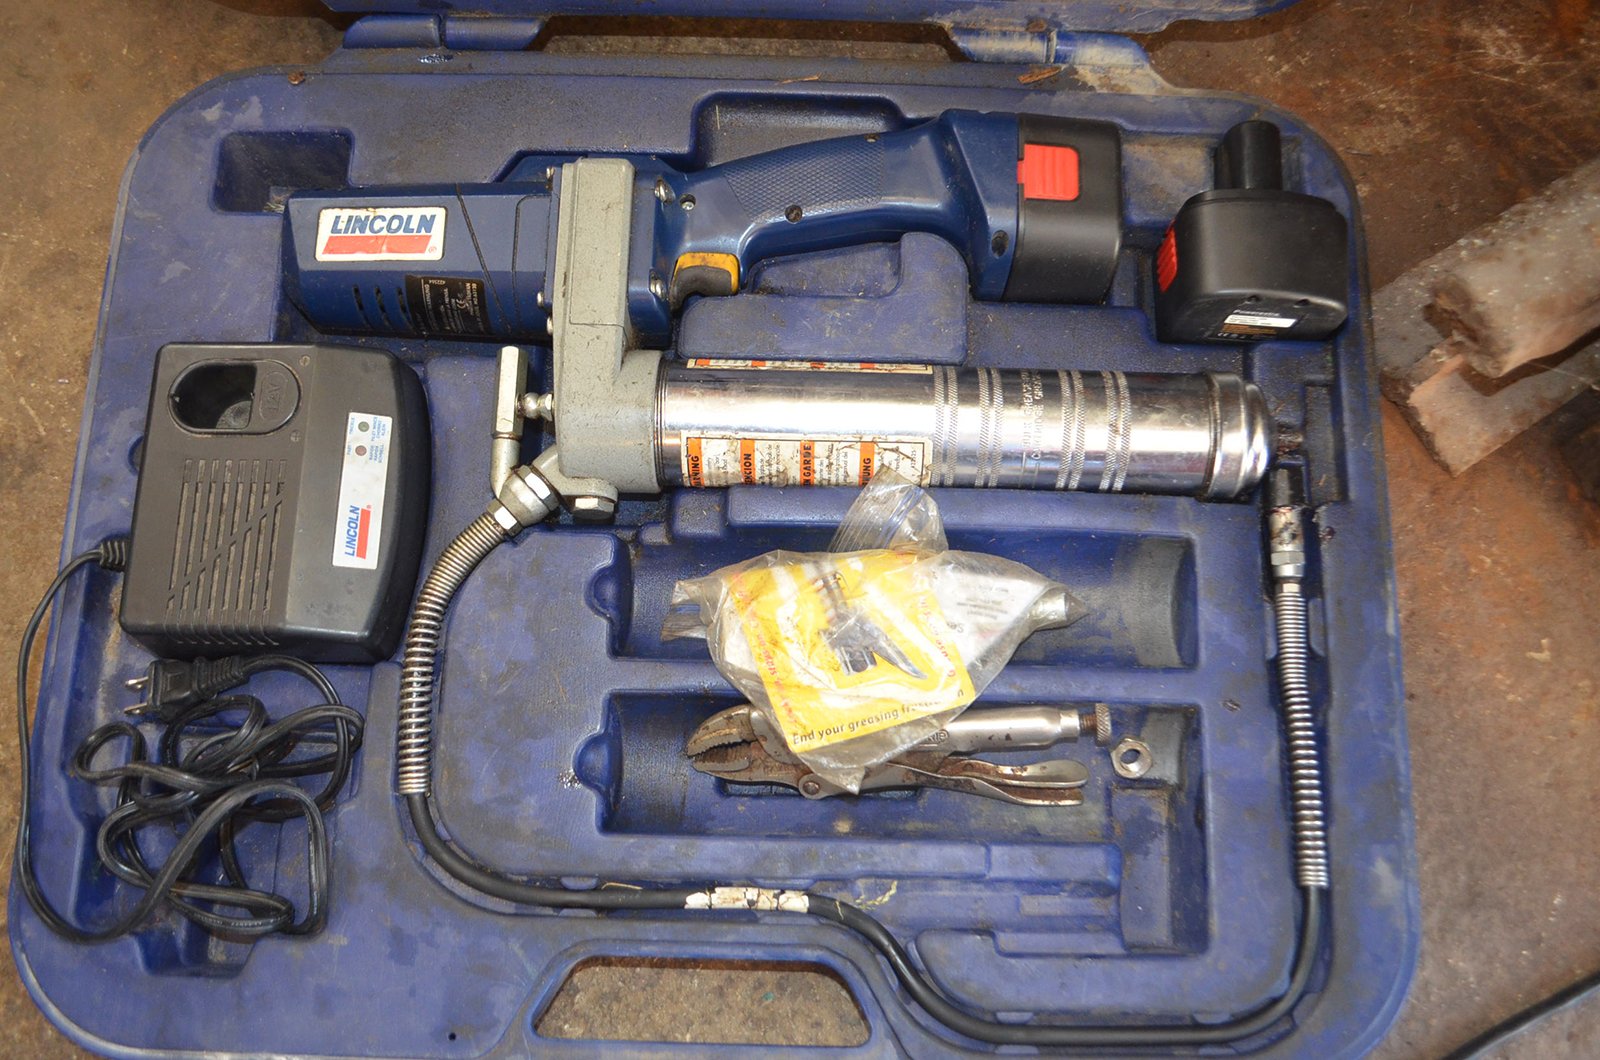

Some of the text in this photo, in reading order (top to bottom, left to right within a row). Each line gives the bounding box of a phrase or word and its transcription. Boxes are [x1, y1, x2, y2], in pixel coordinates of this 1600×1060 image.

[330, 214, 437, 235] LINCOLN
[690, 455, 702, 486] ARNING
[742, 453, 753, 484] ENCION
[803, 444, 812, 477] GARDE
[344, 505, 360, 557] LINCOLN
[793, 709, 899, 745] End your greasing
